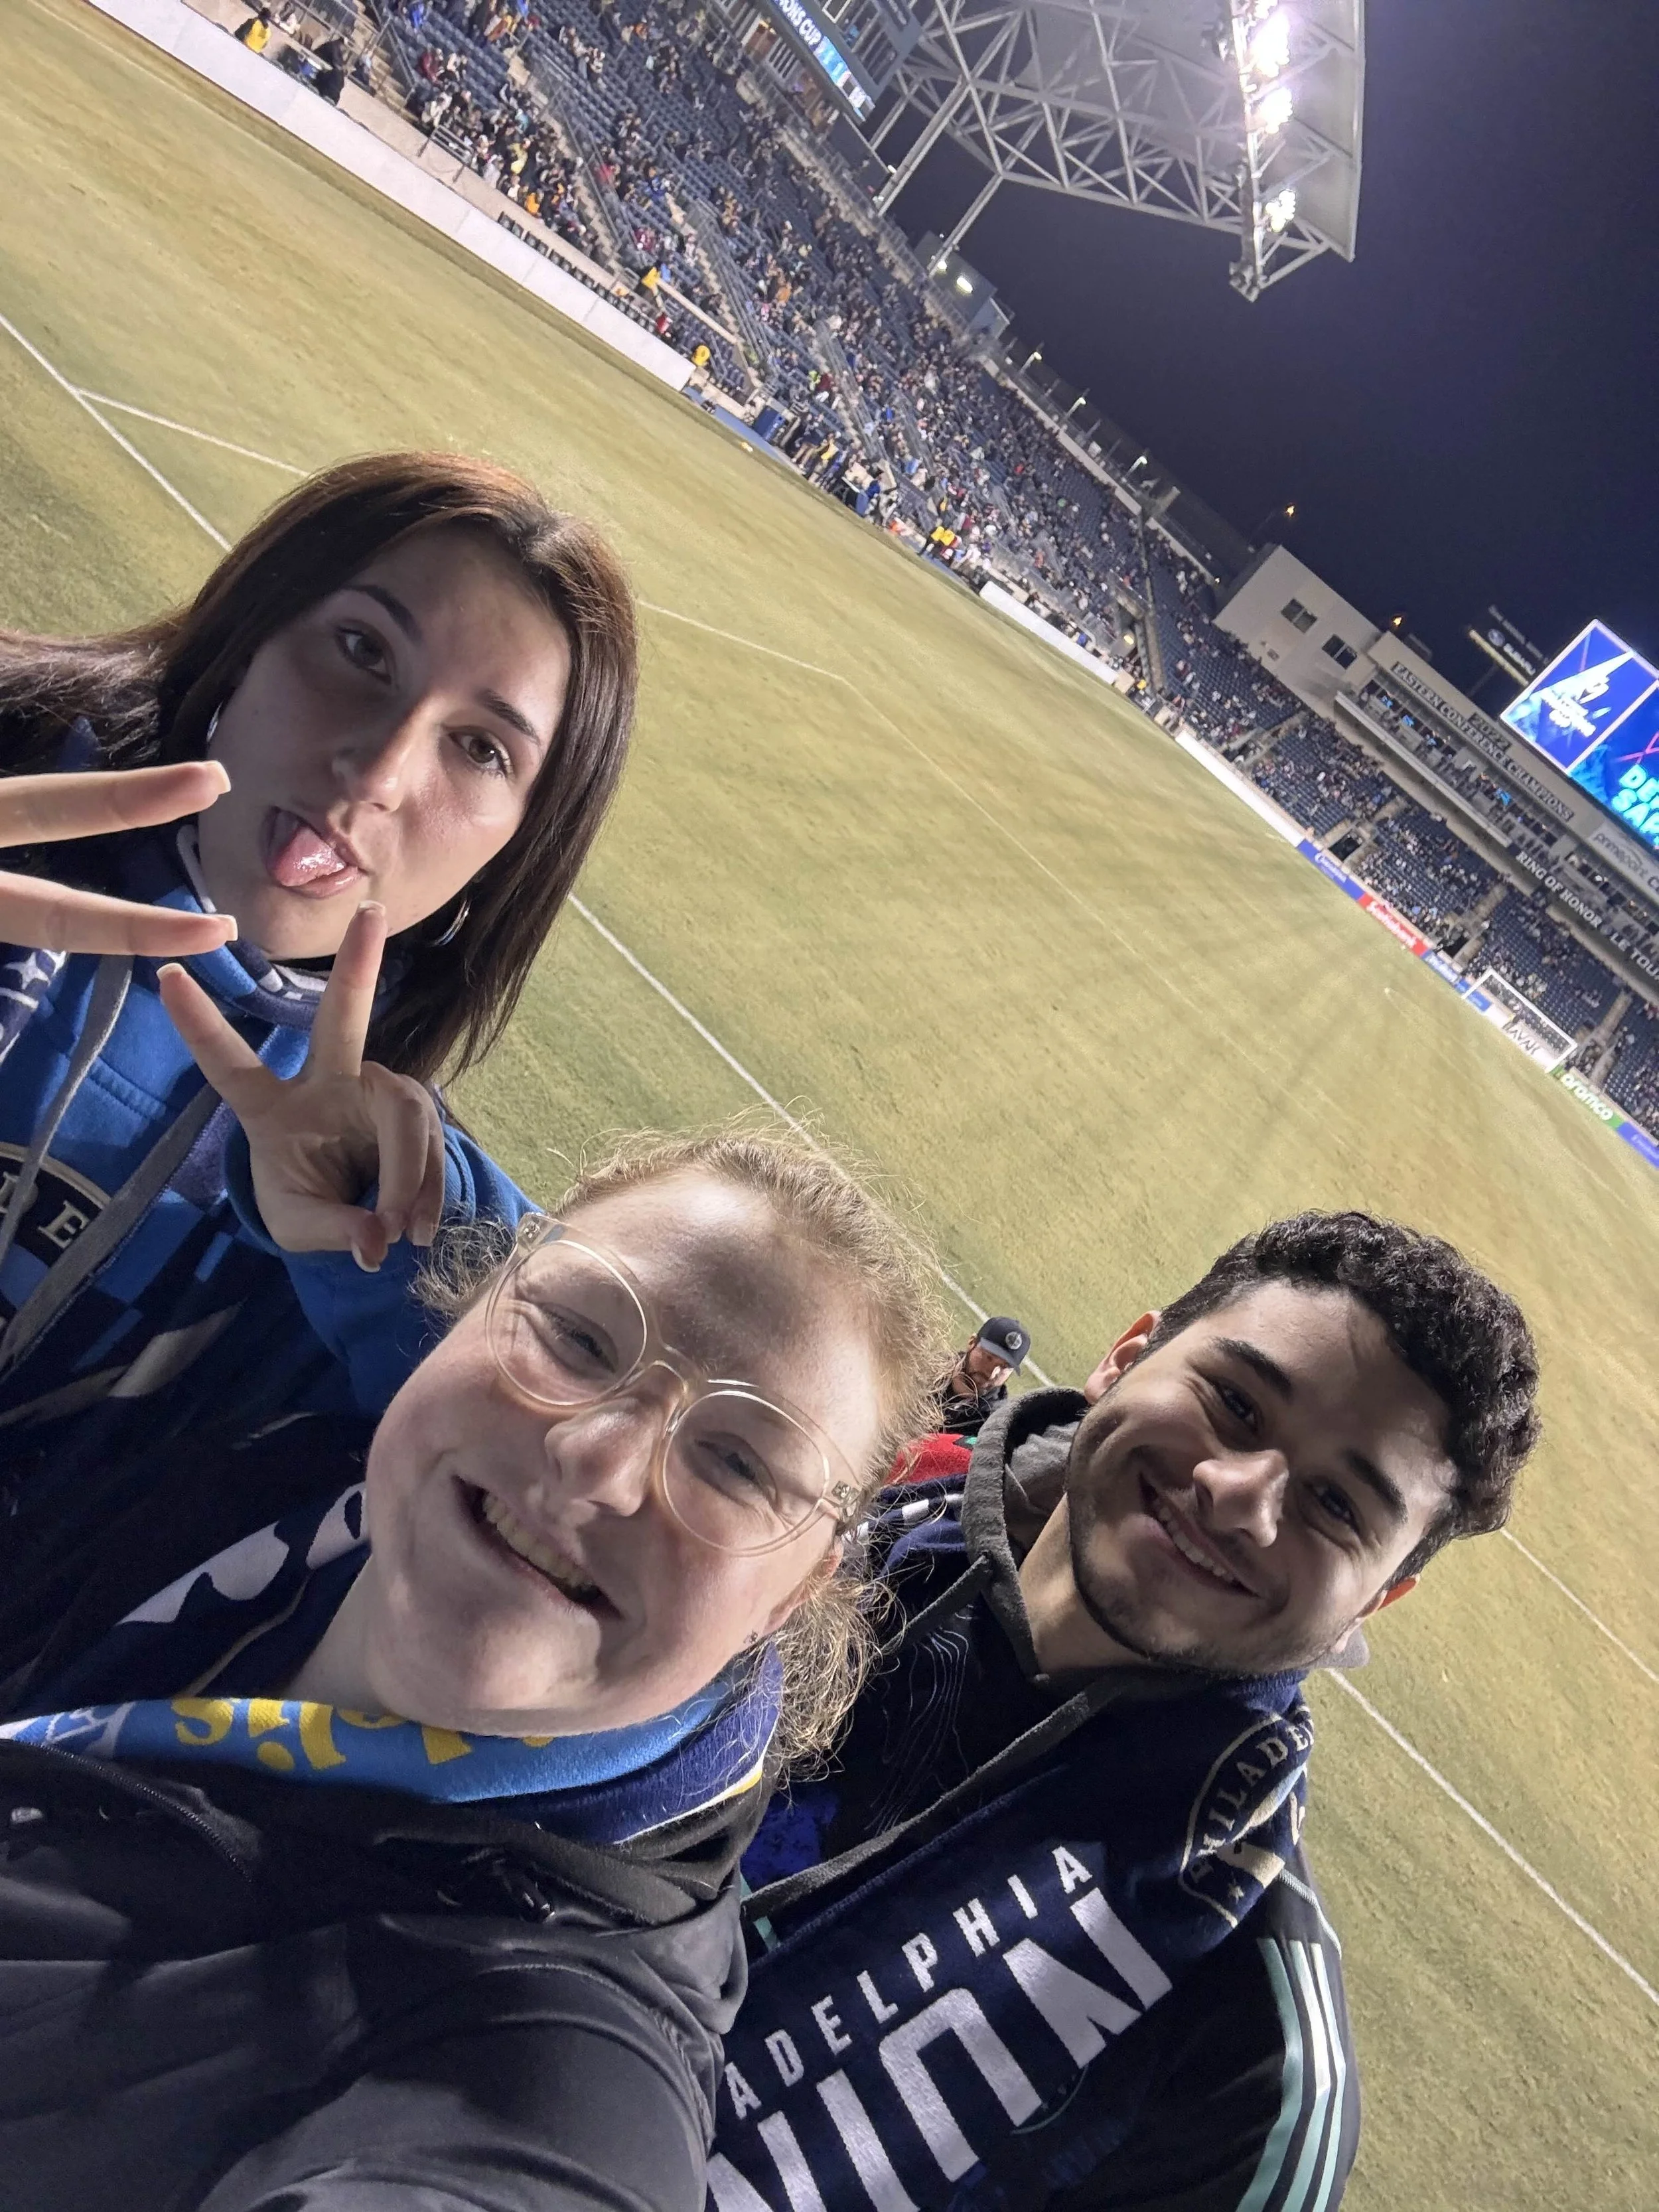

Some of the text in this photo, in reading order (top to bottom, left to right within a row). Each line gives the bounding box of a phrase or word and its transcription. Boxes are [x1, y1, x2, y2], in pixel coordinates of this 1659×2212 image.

[799, 17, 822, 45] CUP
[1392, 662, 1441, 710] EASTERN
[1440, 707, 1510, 766] CONFERENCE
[1506, 763, 1574, 821] CHAMPIONS
[1469, 713, 1510, 751] 2022
[1516, 851, 1547, 880] RING
[1544, 875, 1564, 893] OF
[1559, 890, 1603, 928] HONOR
[1610, 932, 1630, 952] LE
[1561, 1072, 1614, 1121] aramco
[724, 1846, 1093, 2120] ADELPHIA
